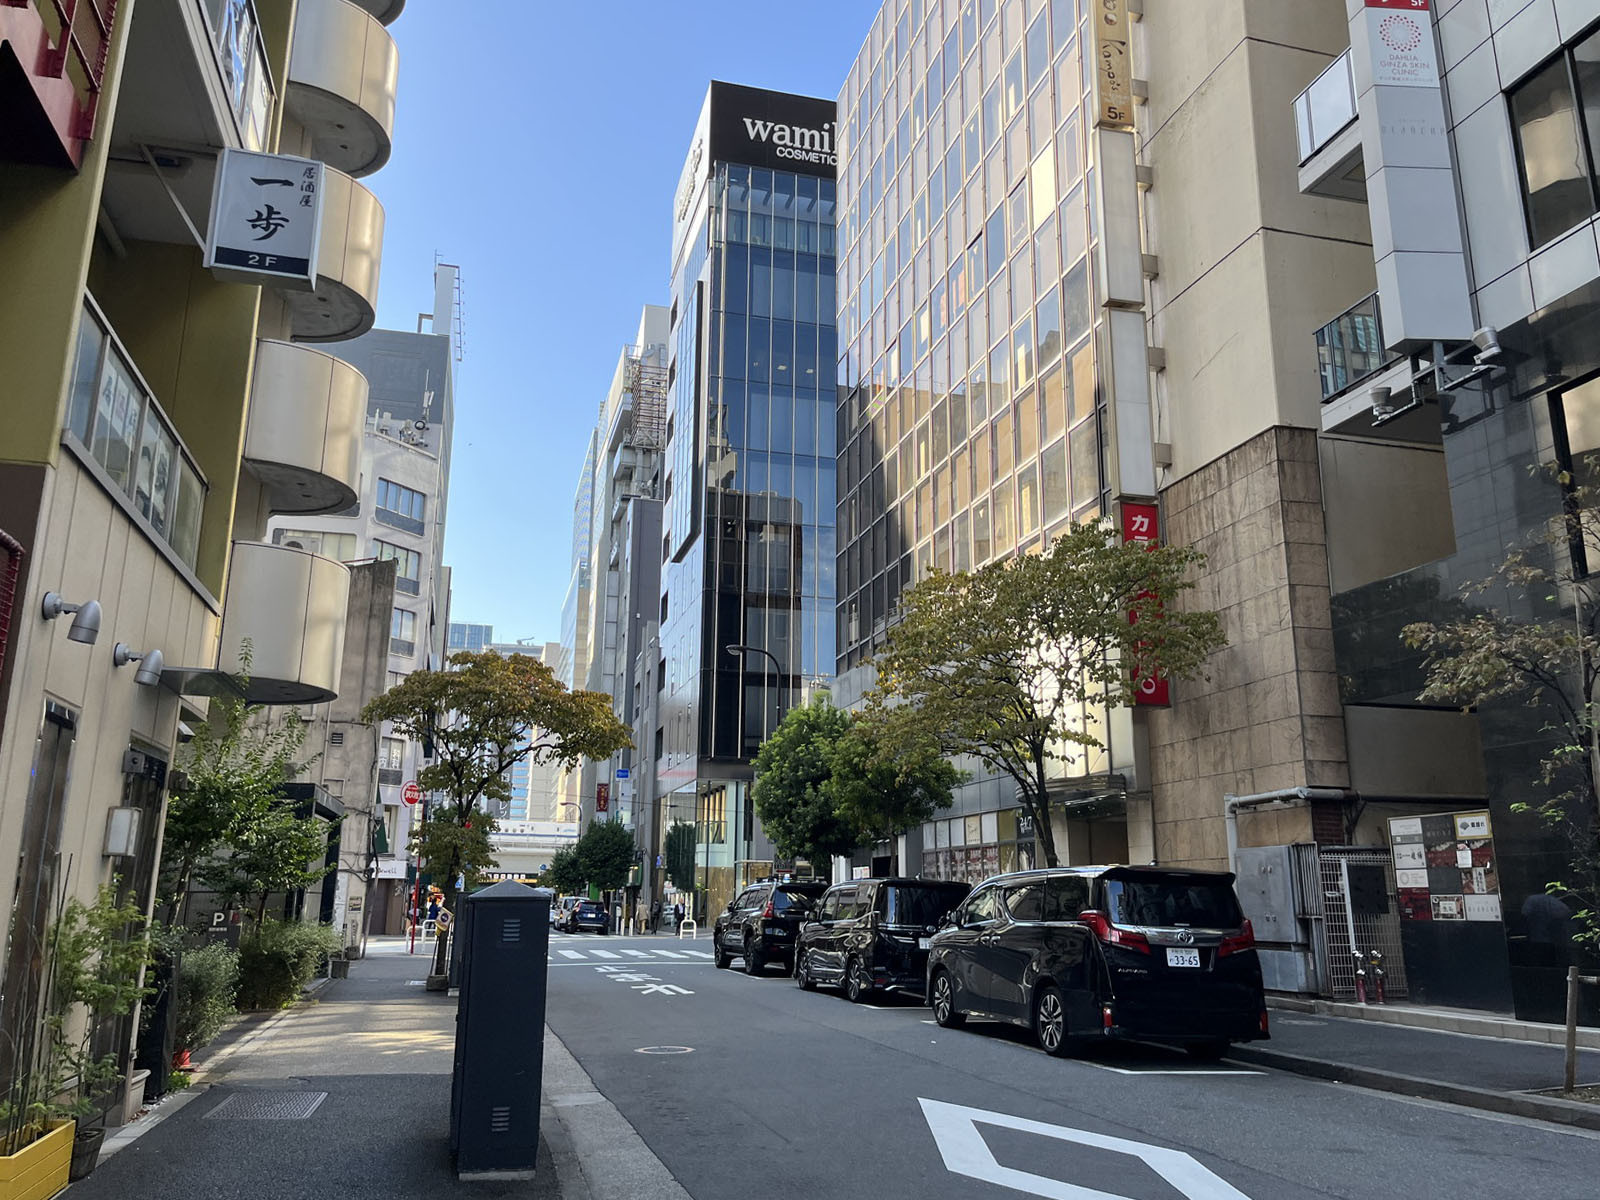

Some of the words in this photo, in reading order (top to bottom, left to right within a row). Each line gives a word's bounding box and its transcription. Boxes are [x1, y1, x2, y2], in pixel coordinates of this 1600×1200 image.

[1391, 68, 1419, 76] CLINIC
[1410, 62, 1430, 70] SKIN
[1107, 106, 1125, 121] 5F
[299, 167, 316, 208] 居酒屋
[246, 175, 295, 241] 一歩
[248, 254, 278, 267] 2F
[212, 912, 225, 926] P
[1174, 955, 1199, 966] 33-65
[594, 965, 696, 995] 止まれ
